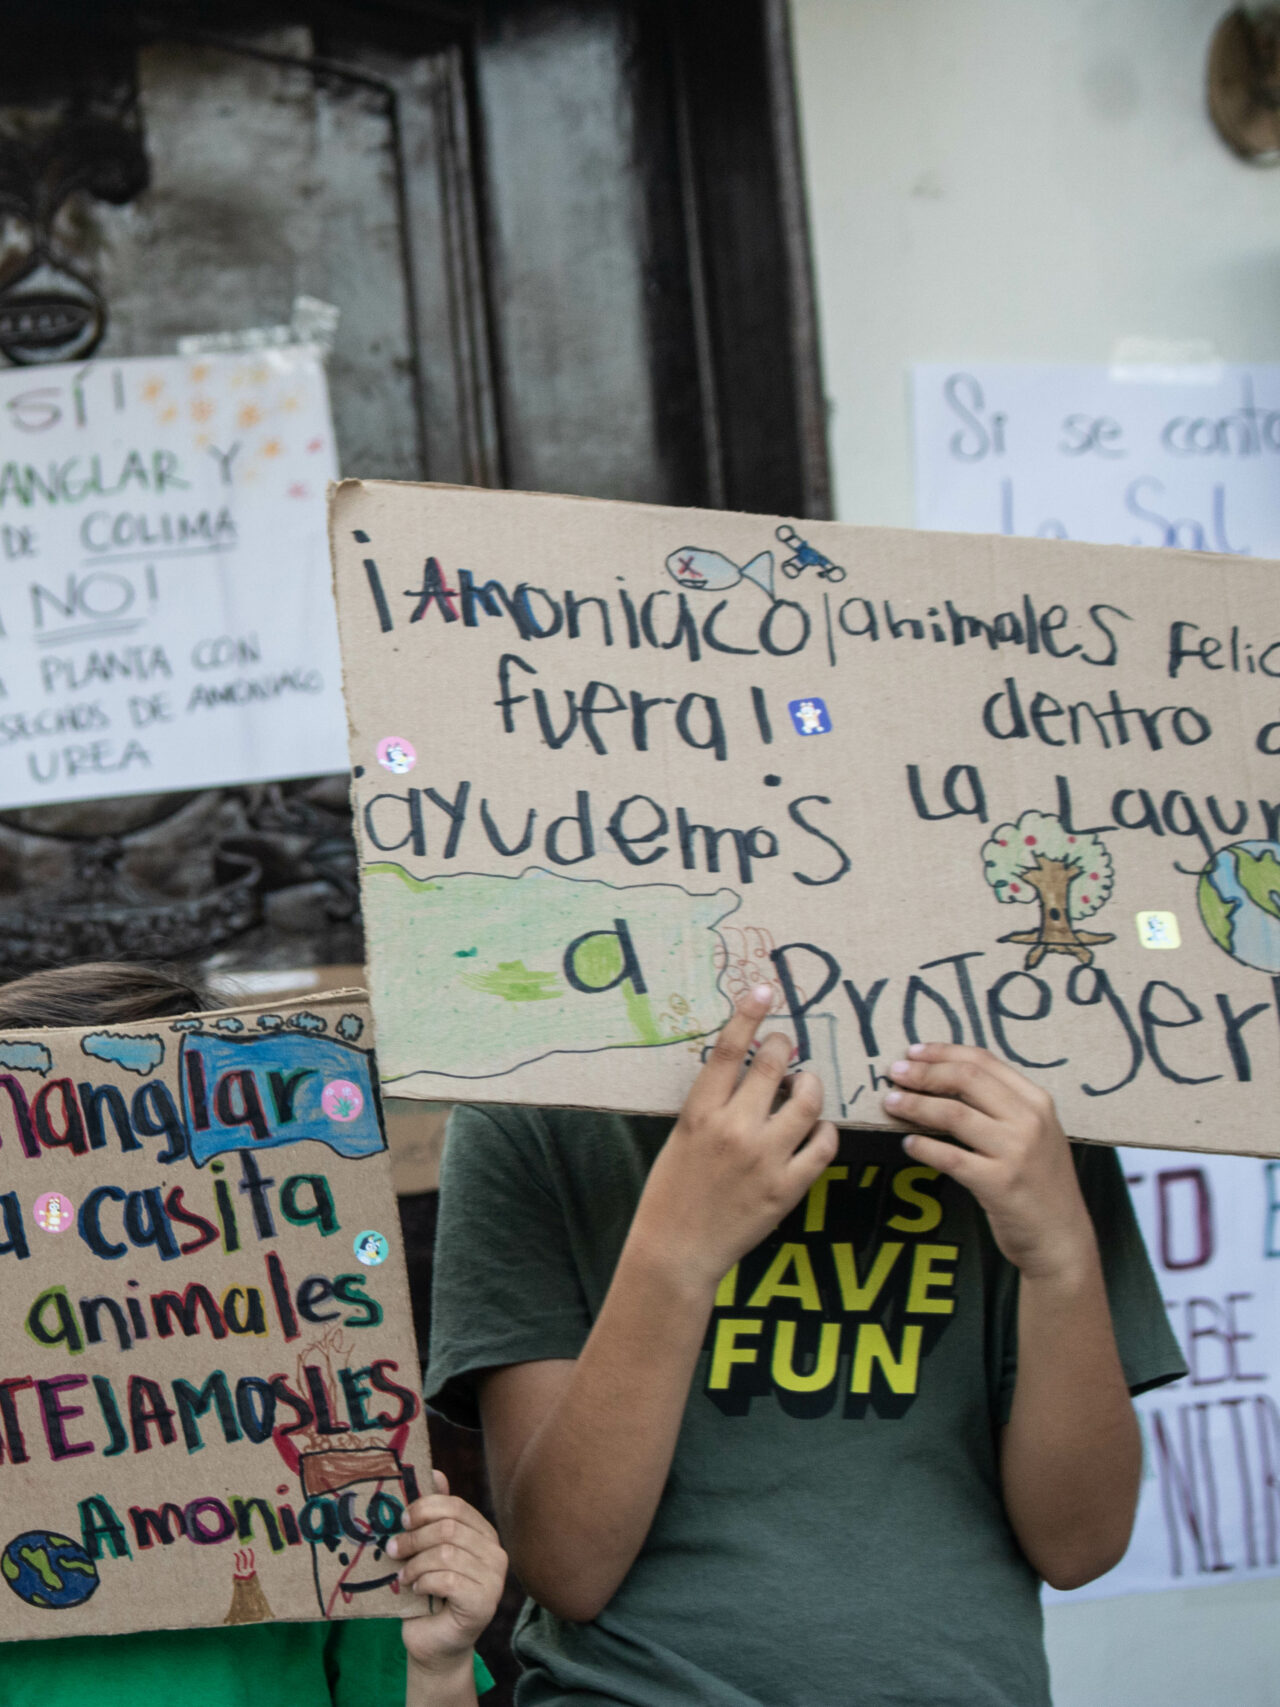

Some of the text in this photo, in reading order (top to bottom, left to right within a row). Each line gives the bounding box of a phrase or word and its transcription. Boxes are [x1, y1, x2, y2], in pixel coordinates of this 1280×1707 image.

[943, 371, 1008, 463] Si
[1060, 412, 1127, 459] se
[207, 442, 241, 484] Y
[2, 523, 40, 561] DE
[80, 508, 239, 557] COLIMA
[40, 644, 173, 696] PLANTA
[191, 633, 262, 670] CON
[129, 694, 174, 730] DE
[983, 676, 1212, 751] dentro
[28, 739, 154, 785] UREA
[563, 918, 648, 996] a
[77, 1150, 342, 1261] casita
[802, 1165, 943, 1232] T'S
[24, 1250, 384, 1355] animales
[707, 1318, 924, 1396] FUN
